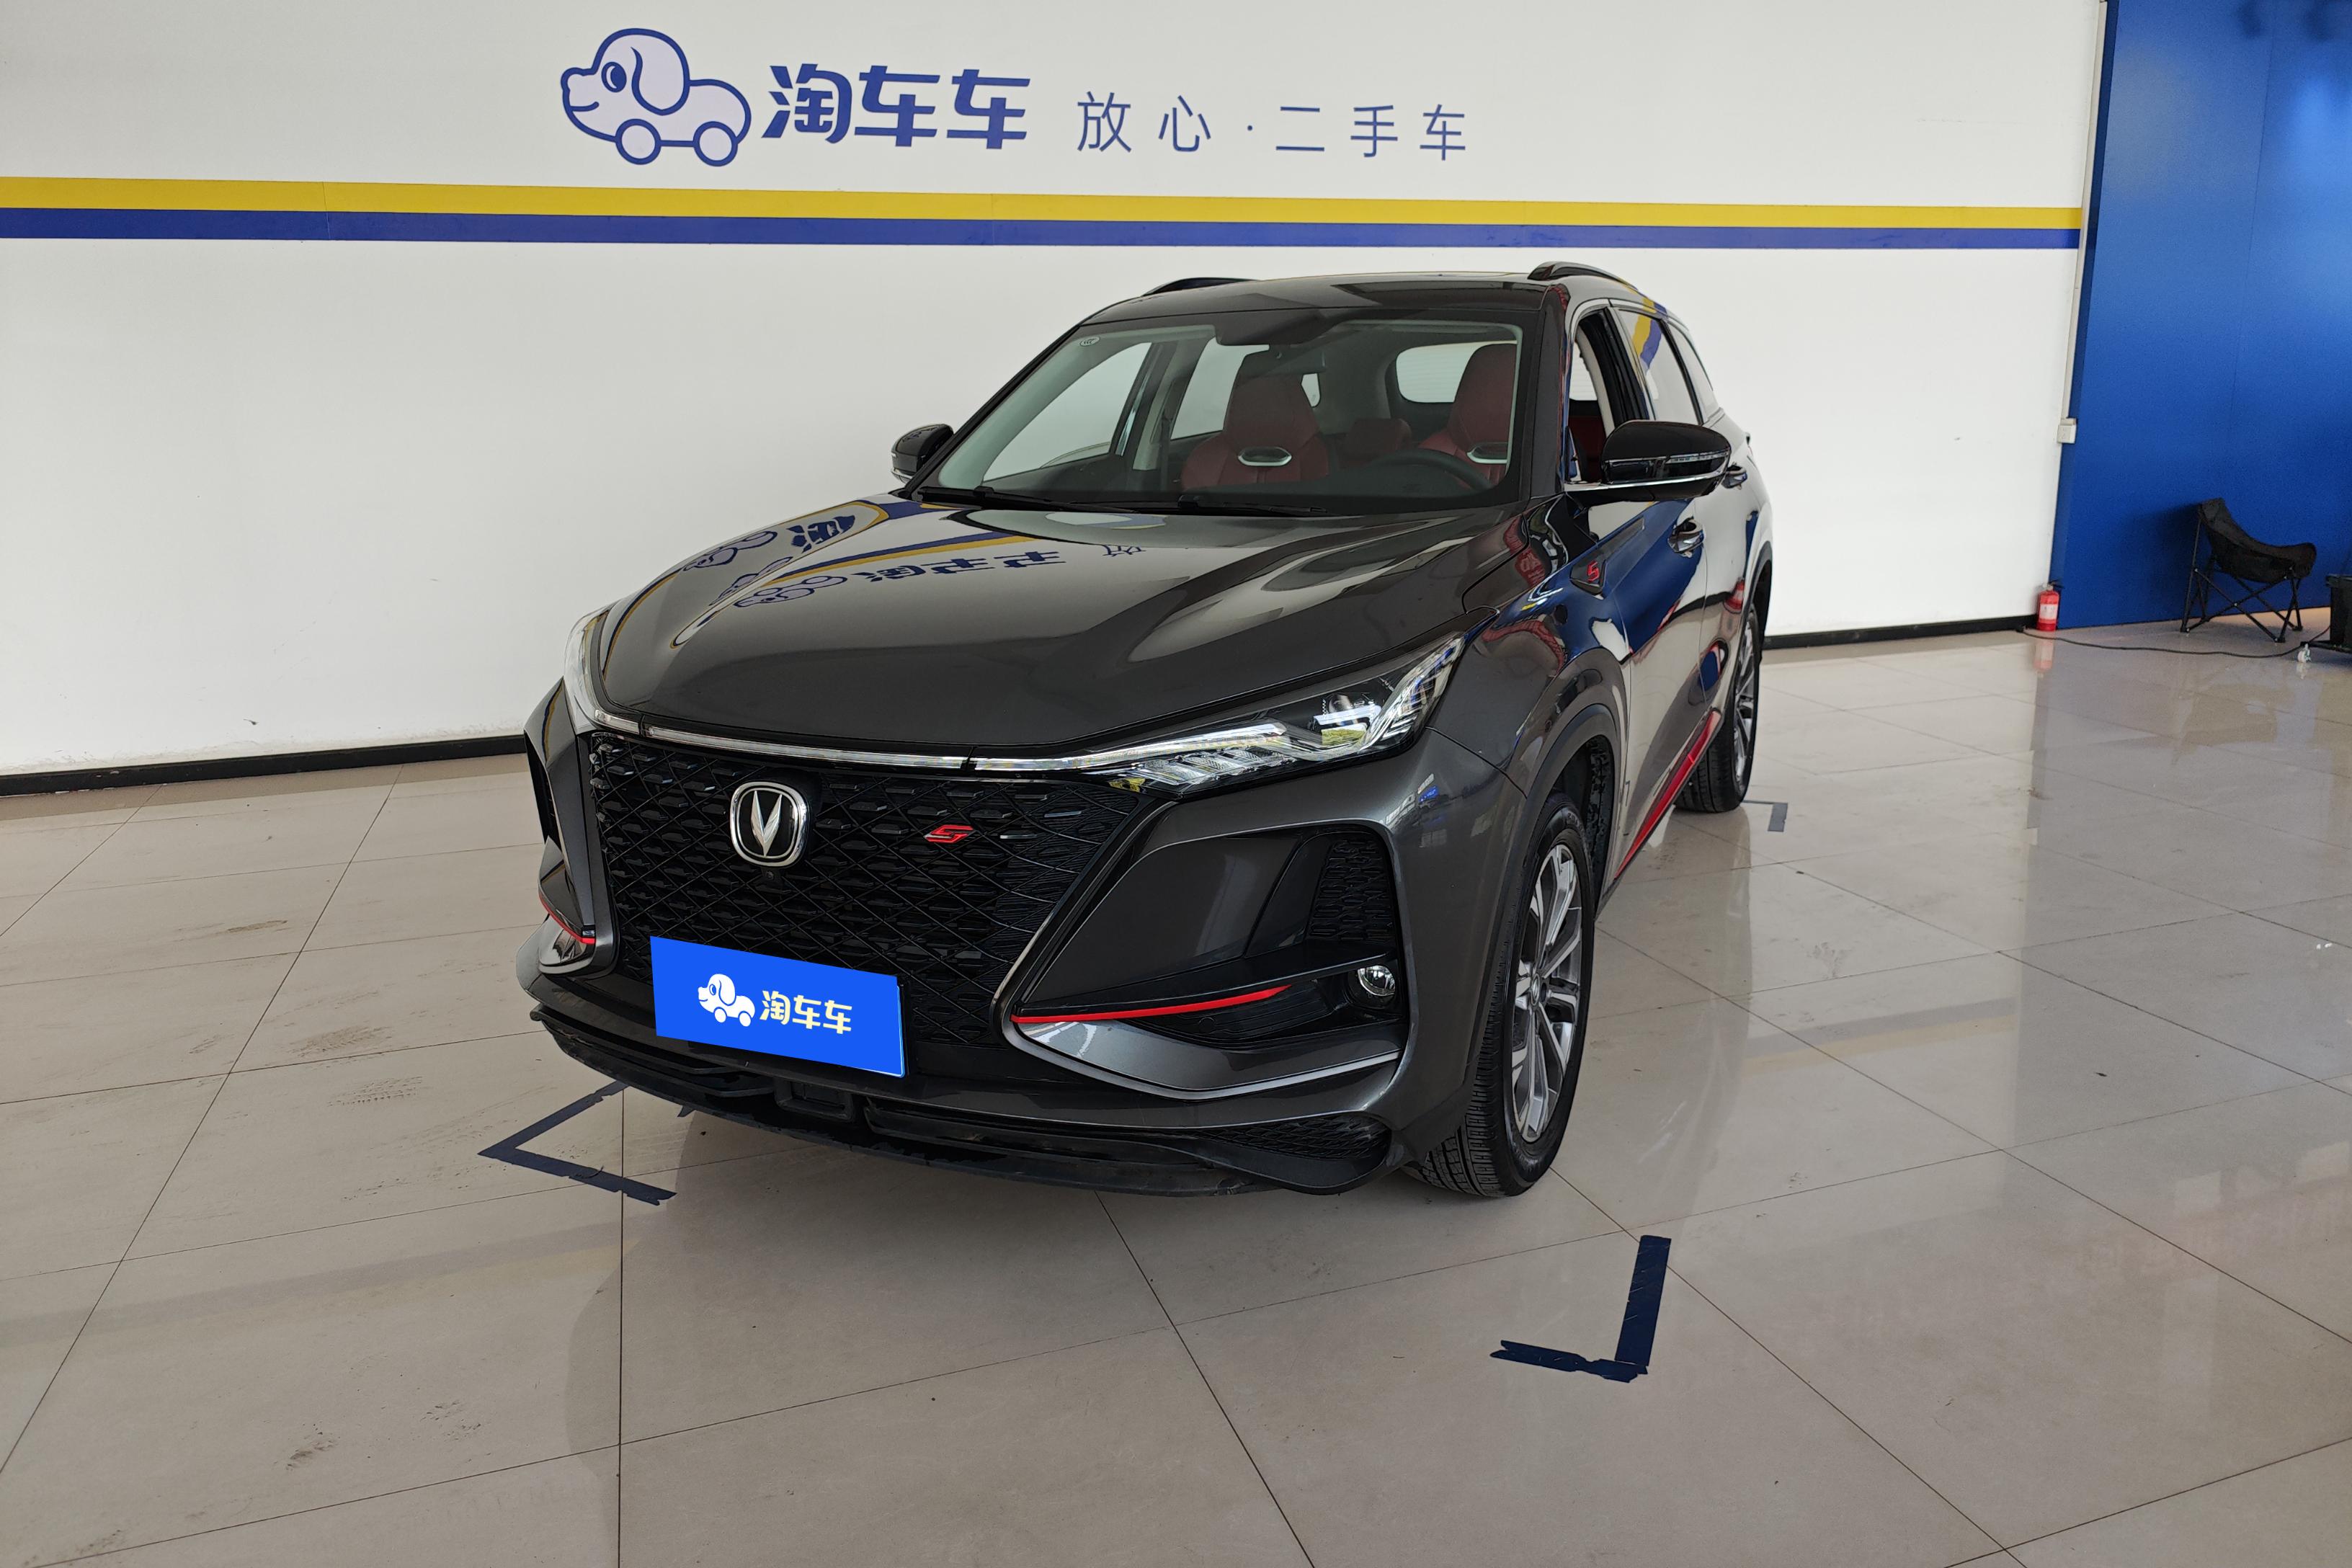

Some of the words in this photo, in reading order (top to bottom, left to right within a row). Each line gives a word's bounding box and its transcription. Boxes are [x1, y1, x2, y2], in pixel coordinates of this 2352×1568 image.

[762, 63, 1031, 150] 淘车车
[1078, 91, 1466, 161] 放心·二手车
